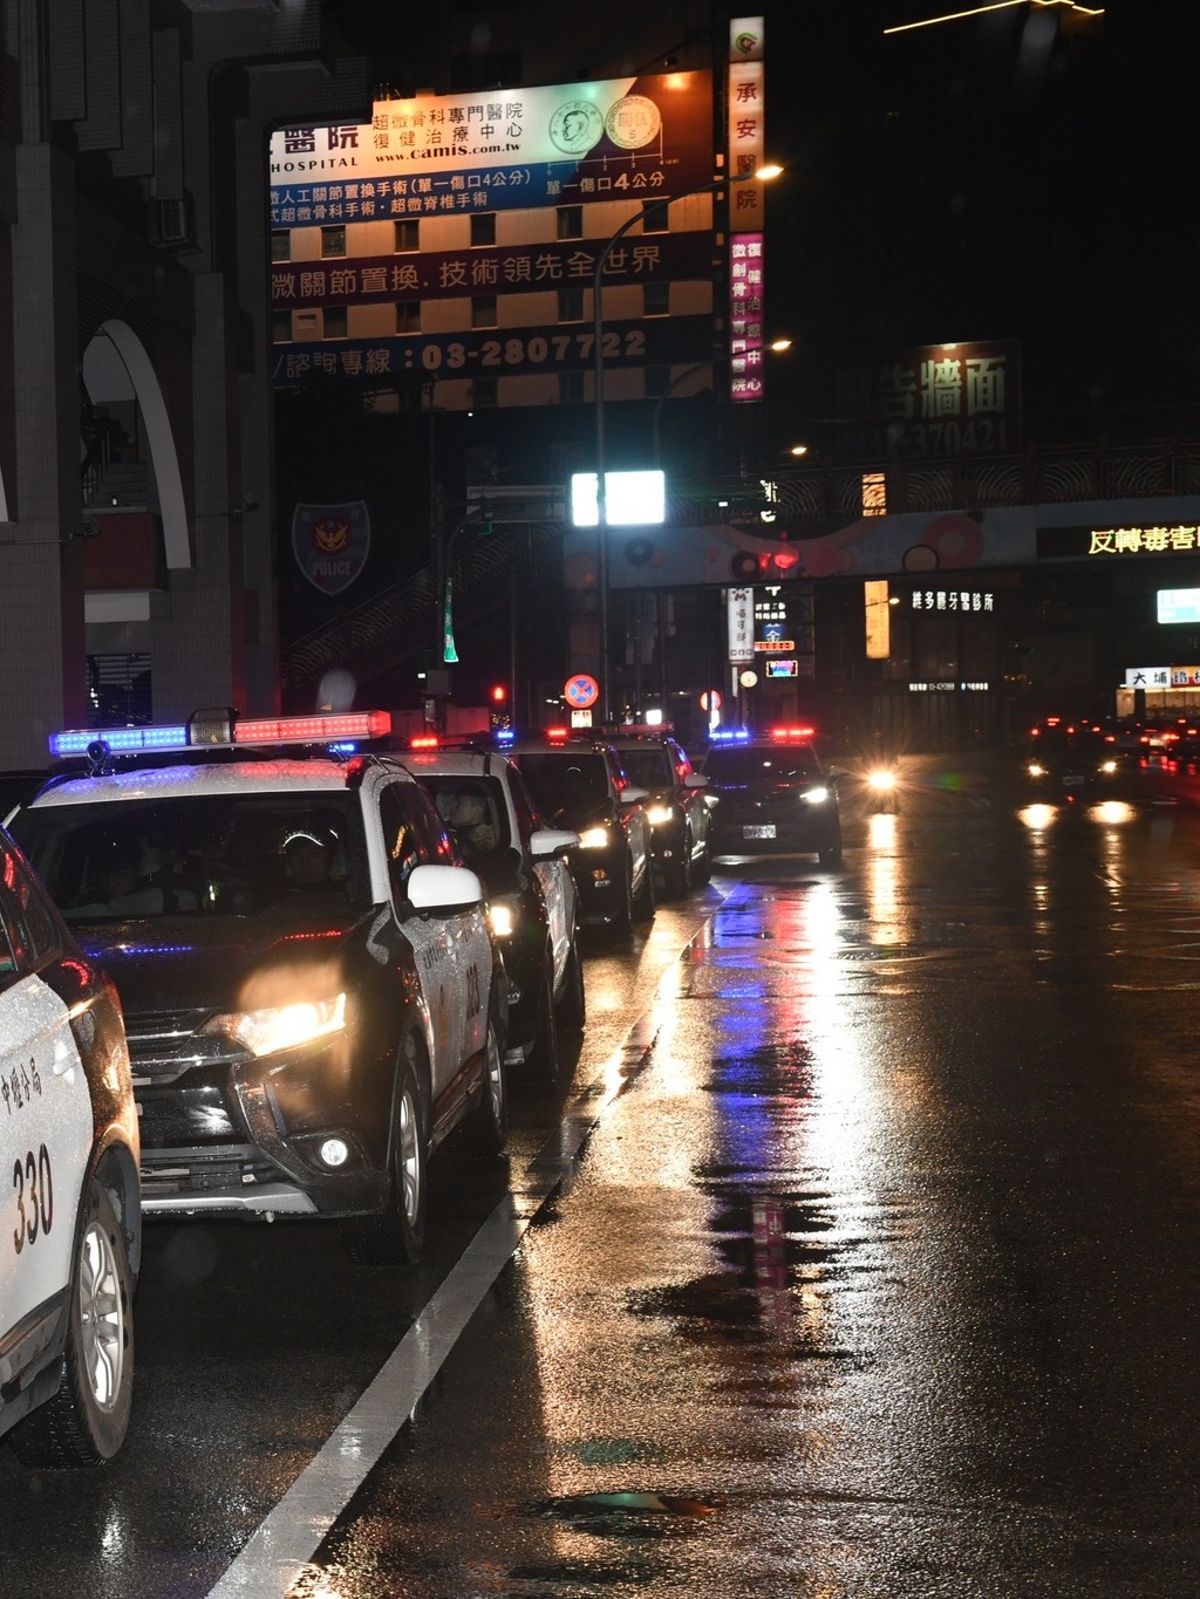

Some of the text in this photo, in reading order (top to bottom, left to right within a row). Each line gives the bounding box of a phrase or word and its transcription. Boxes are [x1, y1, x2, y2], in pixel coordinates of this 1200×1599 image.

[372, 102, 524, 131] 超微骨科專門醫院
[373, 121, 523, 150] 復健治療中心
[736, 82, 757, 209] 承安醫院
[271, 157, 359, 173] HOSPITAL
[375, 142, 521, 163] www.camis.com.tw
[546, 171, 665, 195] 單一傷口4公分
[1088, 525, 1200, 555] 反轉毒害
[0, 1056, 42, 1116] 中壢分局
[13, 1142, 53, 1255] 330
